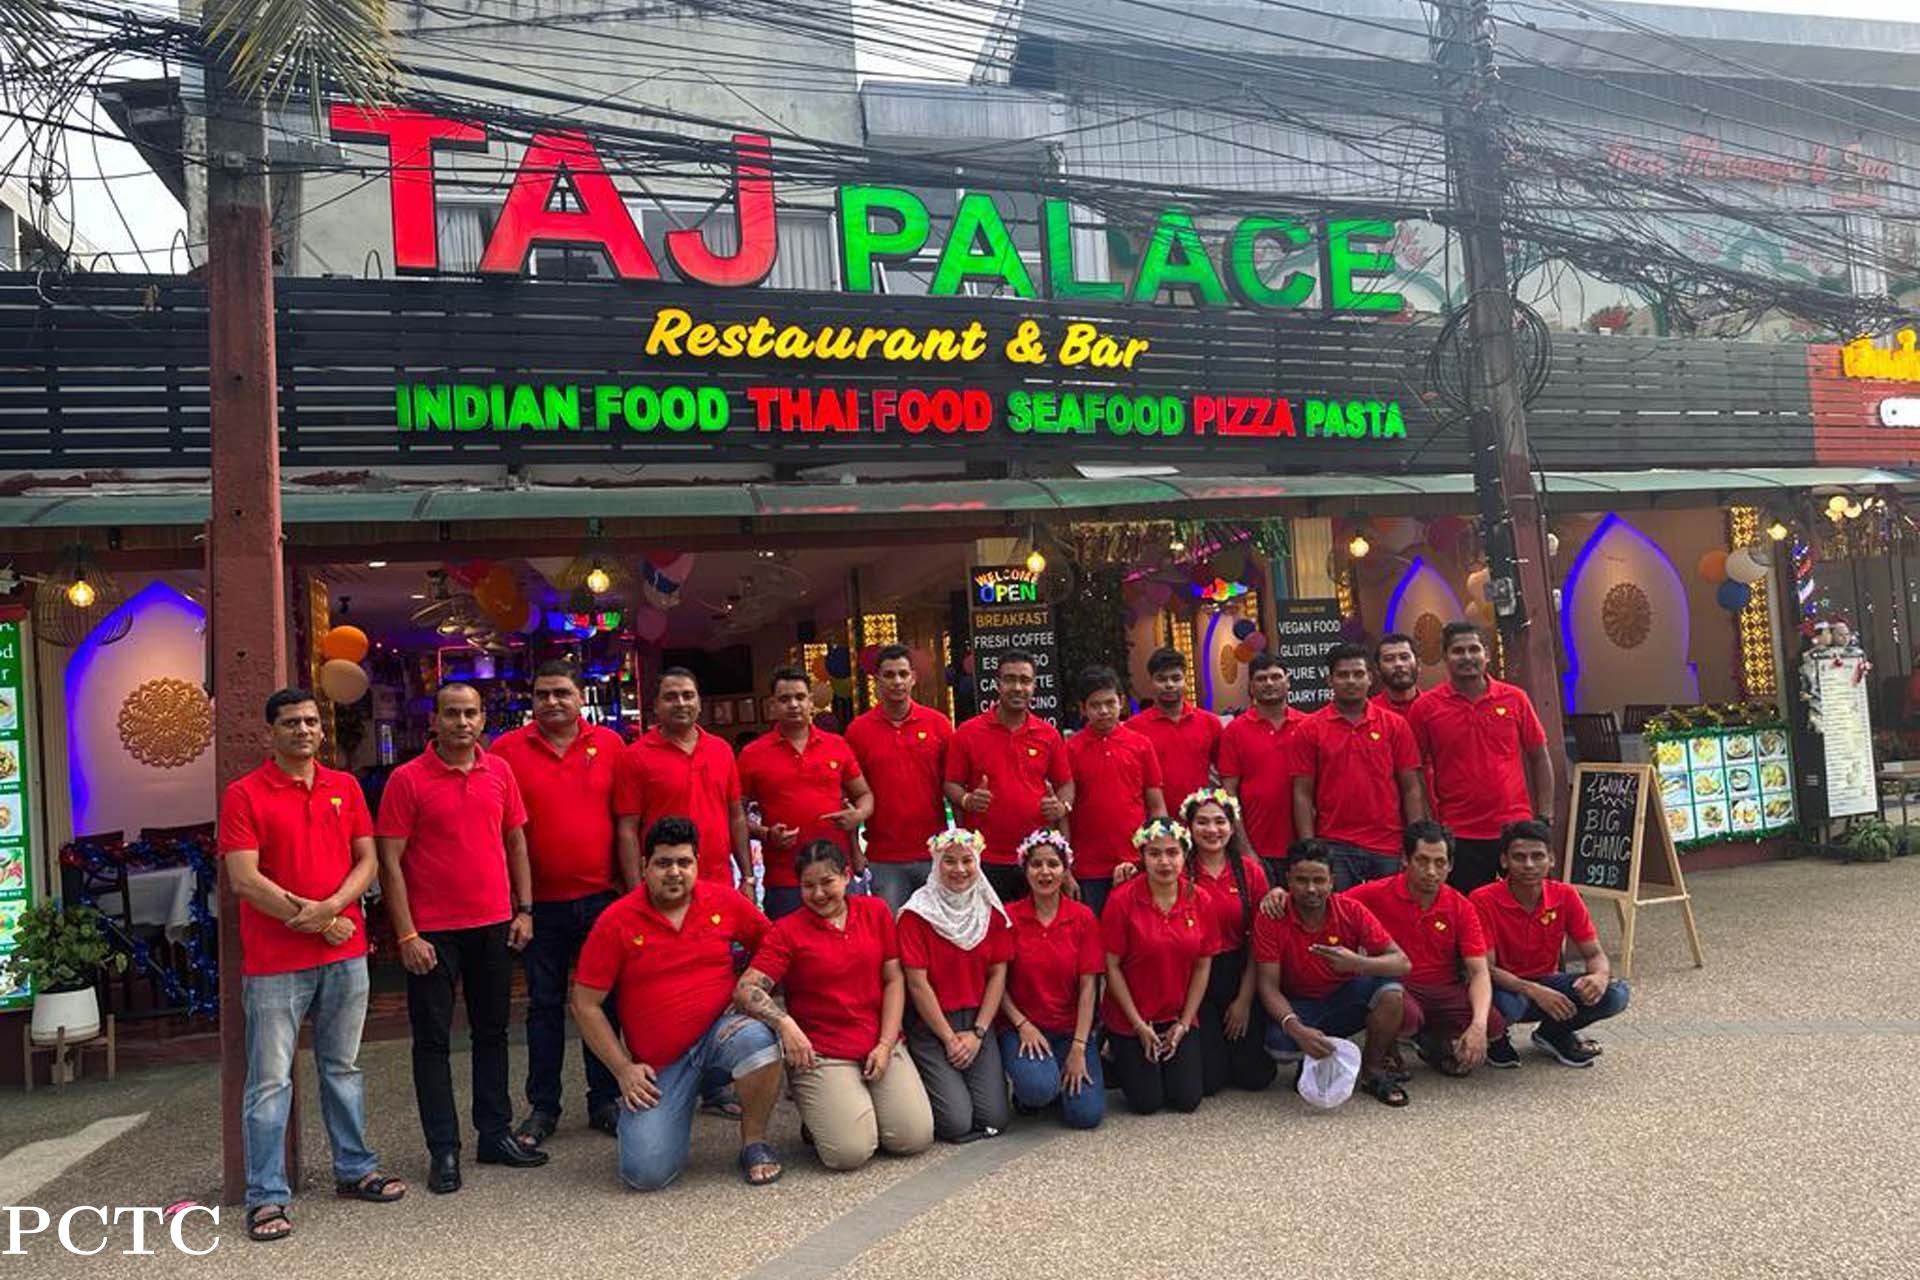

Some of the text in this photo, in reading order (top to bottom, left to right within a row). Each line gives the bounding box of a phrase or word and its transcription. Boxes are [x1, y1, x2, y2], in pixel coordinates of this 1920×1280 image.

[330, 103, 1406, 315] TAJ PALACE
[645, 308, 1150, 369] Restaurant & Bar
[396, 384, 1407, 439] INDIAN FOOD THAI FOOD SEAFOOD PIZZA PASTA
[979, 581, 1037, 602] OPEN
[975, 611, 1049, 628] BREAKFAST
[1278, 620, 1341, 635] VEGAN FOOD
[974, 631, 1054, 649] FRESH COFFEE
[1280, 643, 1317, 657] GLUTEN
[1287, 690, 1316, 704] DAIRY
[1584, 809, 1620, 832] BIG
